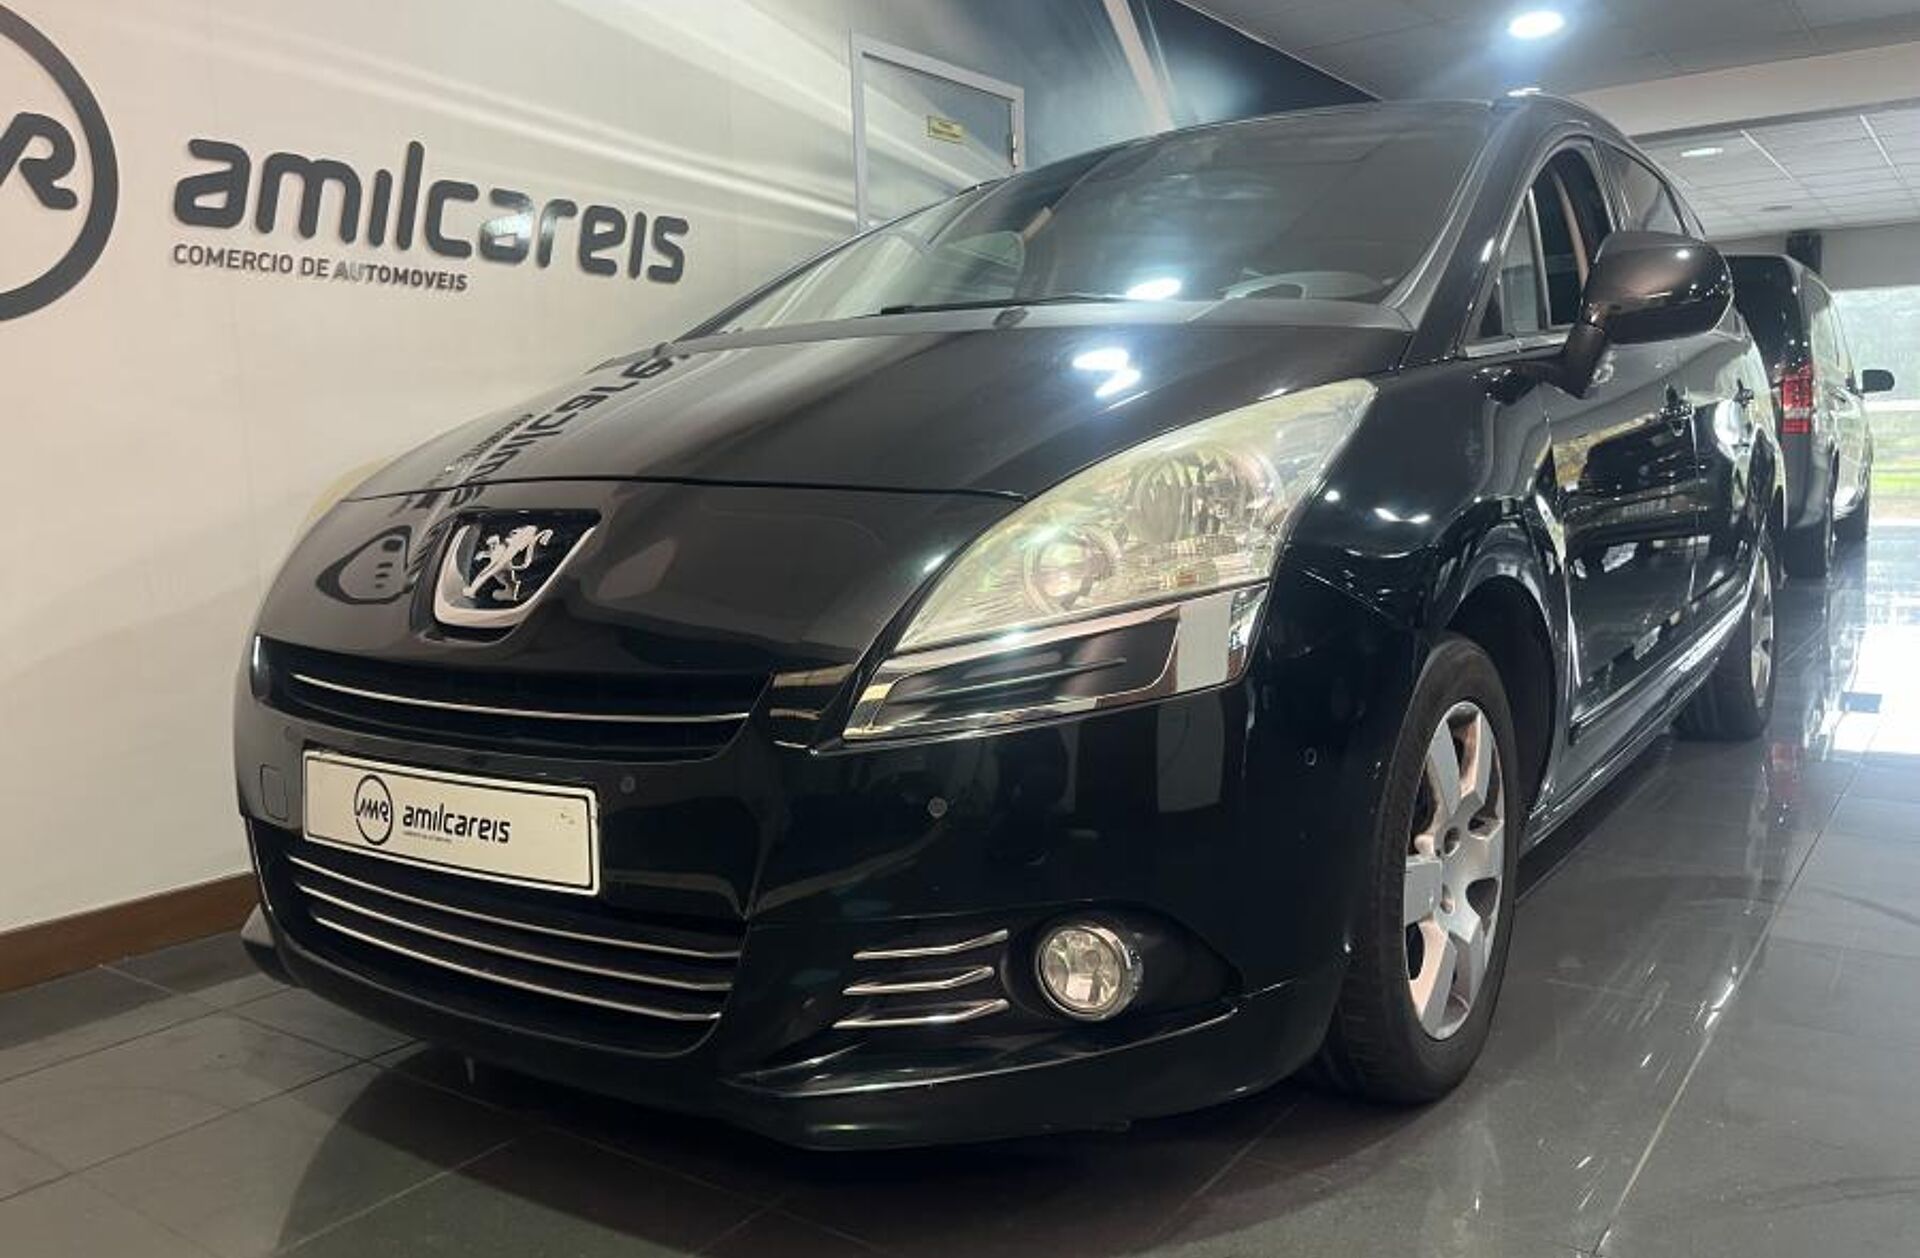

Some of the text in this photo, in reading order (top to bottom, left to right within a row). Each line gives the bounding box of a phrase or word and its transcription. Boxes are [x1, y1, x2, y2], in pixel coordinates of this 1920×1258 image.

[172, 140, 690, 284] amilcareis
[173, 243, 468, 292] COMERCIO DE AUTOMOVEIS
[402, 802, 511, 844] amilcareis
